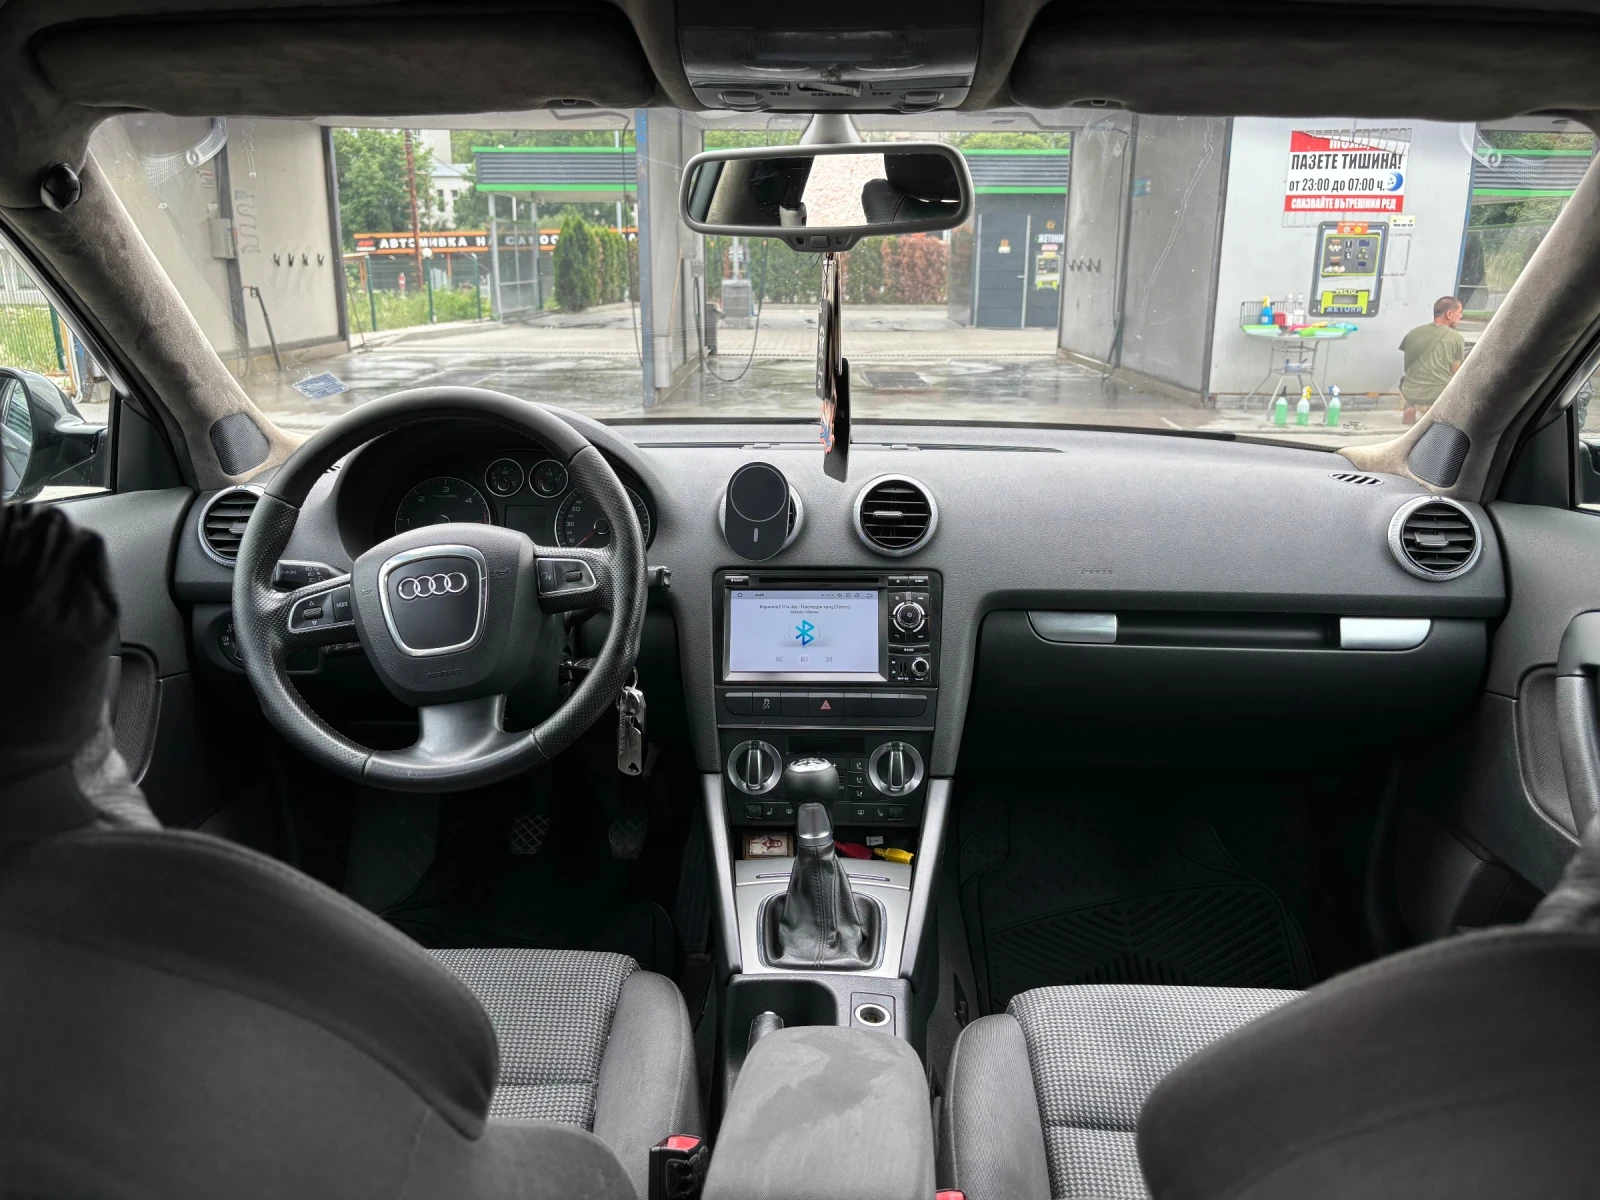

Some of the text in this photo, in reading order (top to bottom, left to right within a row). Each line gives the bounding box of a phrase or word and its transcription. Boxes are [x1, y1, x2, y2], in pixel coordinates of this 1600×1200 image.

[1291, 152, 1402, 170] ПАЗЕТЕ ТИШИНА!
[1289, 178, 1385, 192] от 23:00 до 07:00 ч.
[1291, 196, 1334, 209] СПАЗВАЙТЕ
[1381, 198, 1397, 210] РЕД
